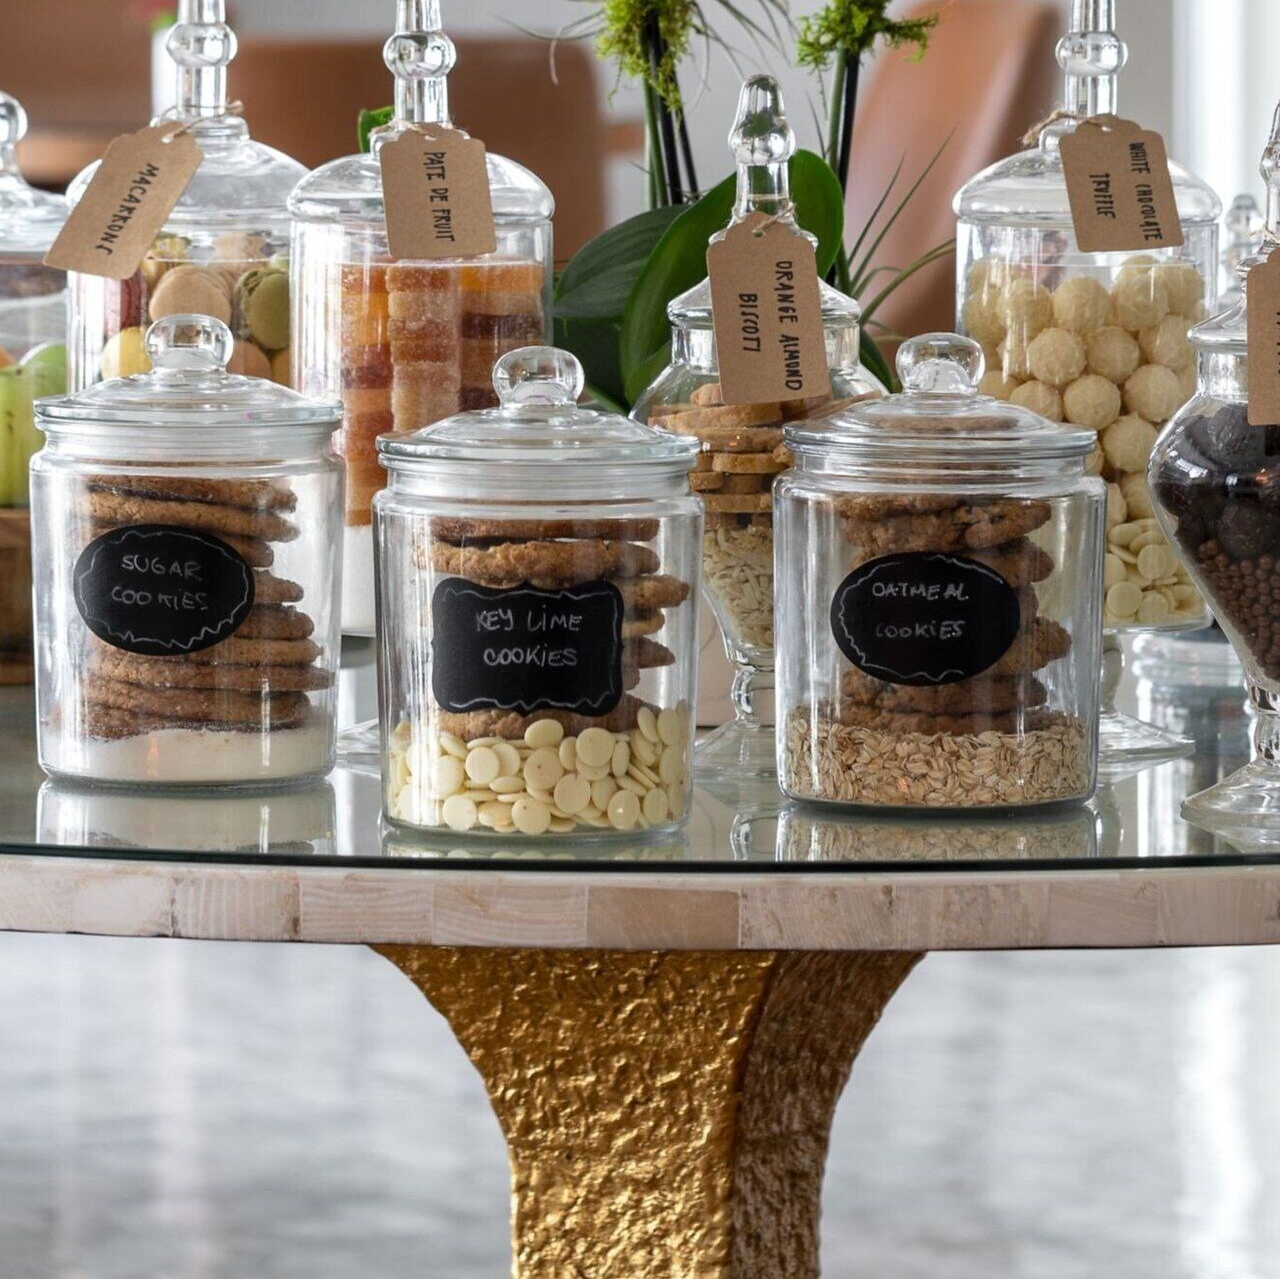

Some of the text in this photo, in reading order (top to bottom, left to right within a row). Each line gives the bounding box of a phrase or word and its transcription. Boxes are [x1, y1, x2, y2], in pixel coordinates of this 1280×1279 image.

[95, 163, 160, 256] MACARRONS
[423, 151, 455, 242] PATE DE FRUIT
[1134, 184, 1163, 241] CHOCOLATE
[774, 260, 803, 391] ORANGE ALMOND
[122, 554, 202, 582] SUGAR
[872, 582, 969, 600] OATMEAL
[476, 608, 514, 632] KEY
